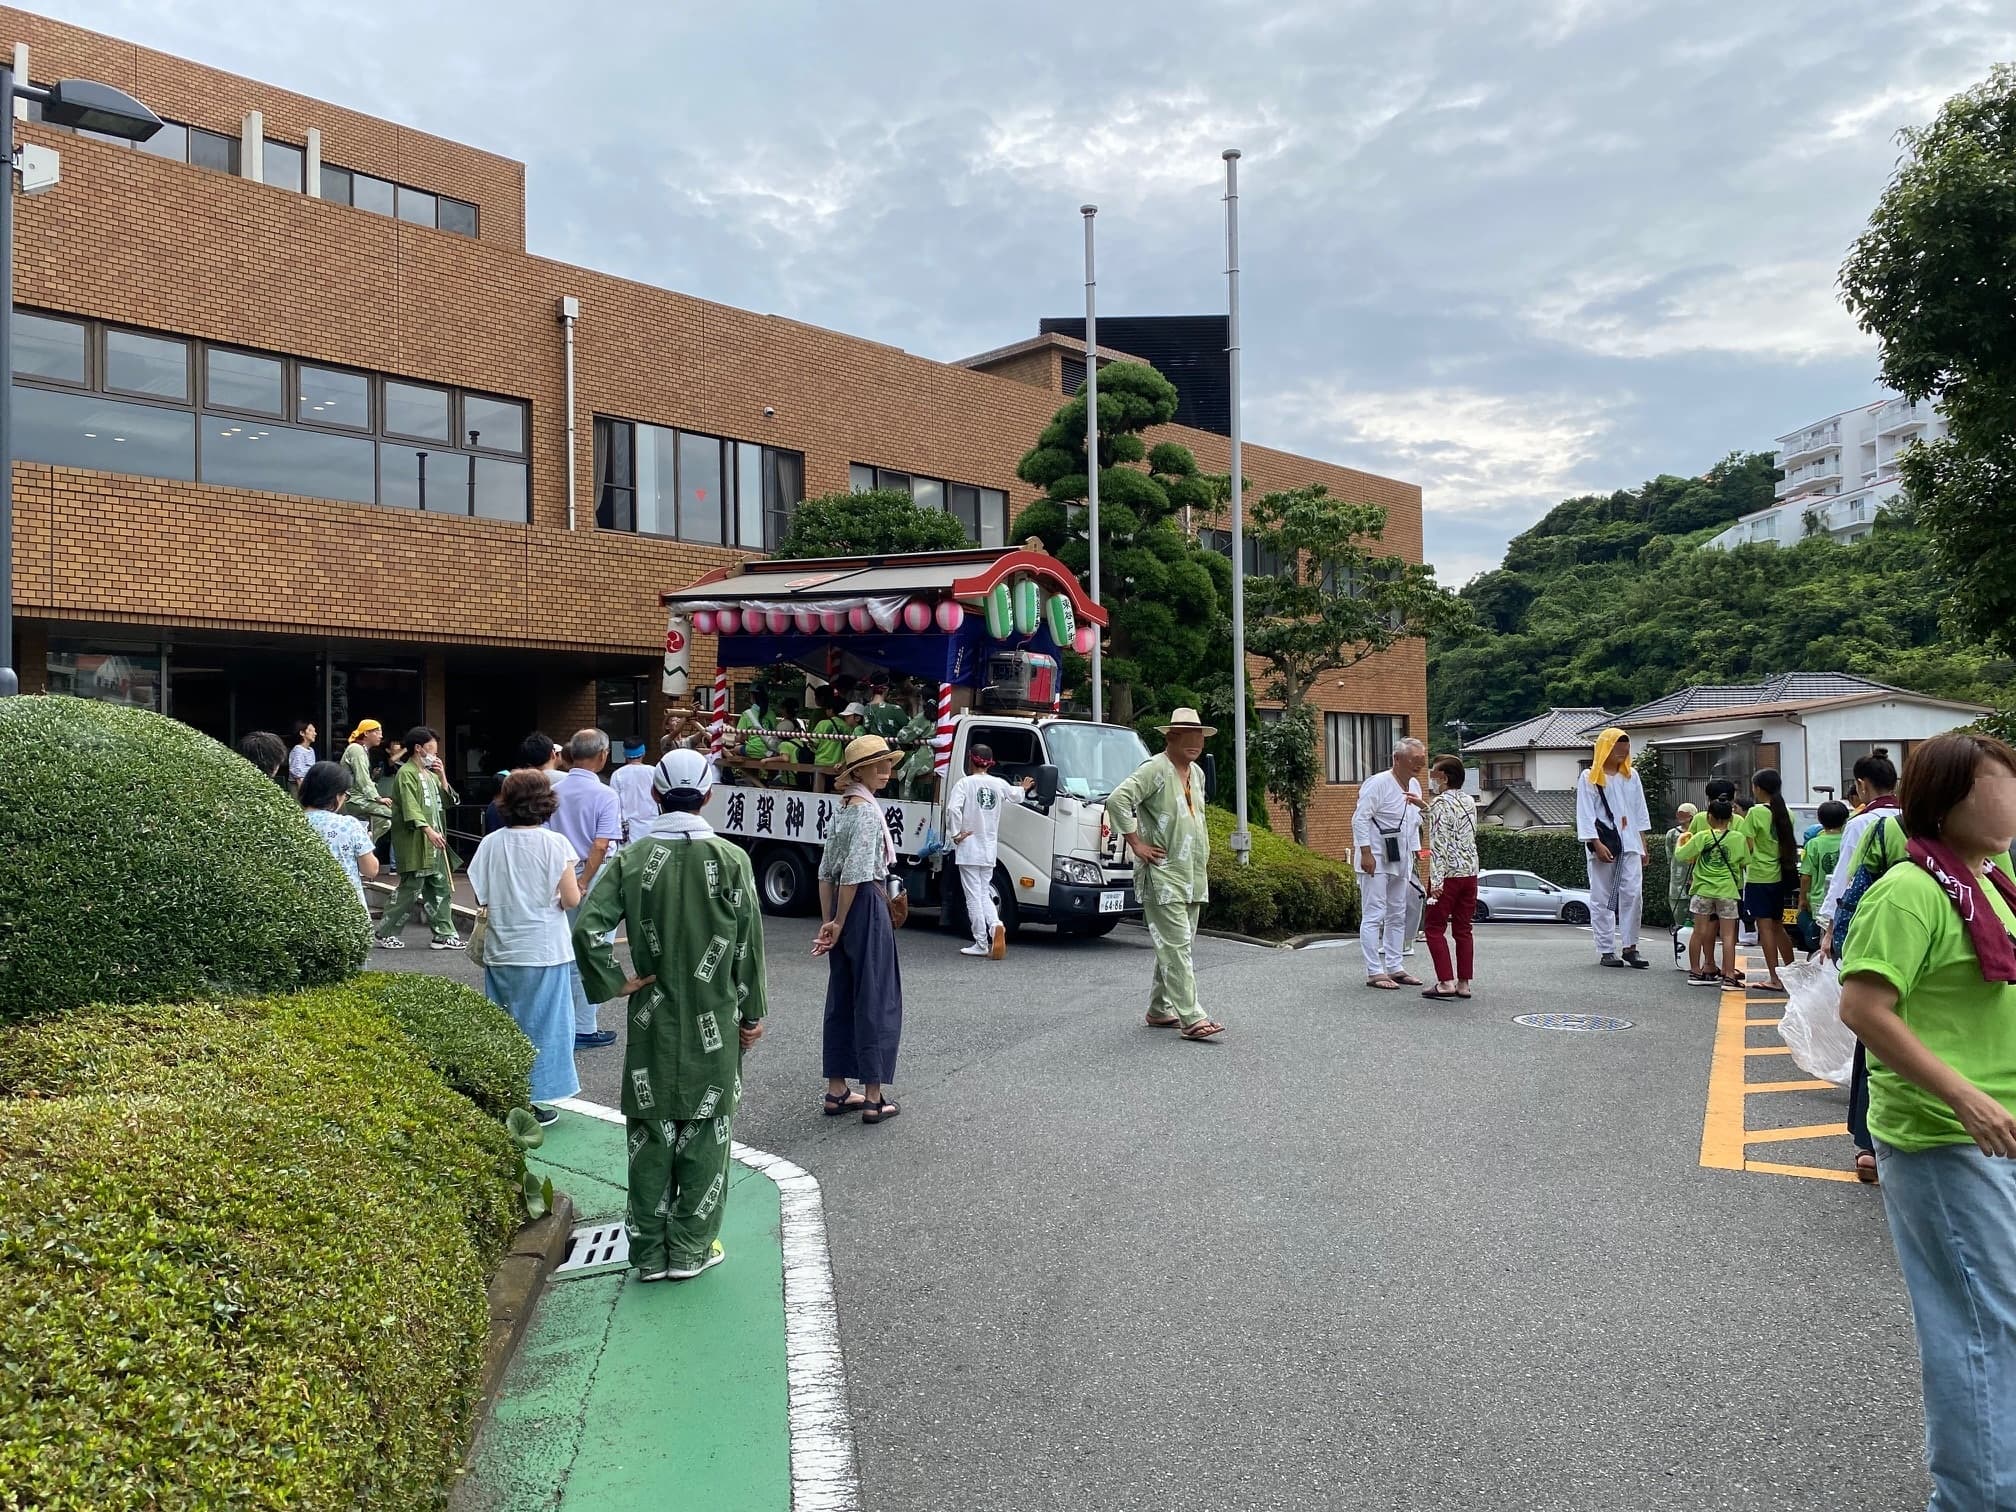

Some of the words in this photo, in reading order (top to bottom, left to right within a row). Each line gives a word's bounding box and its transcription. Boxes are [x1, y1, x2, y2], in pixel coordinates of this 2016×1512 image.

[726, 791, 904, 848] 須賀神社祭
